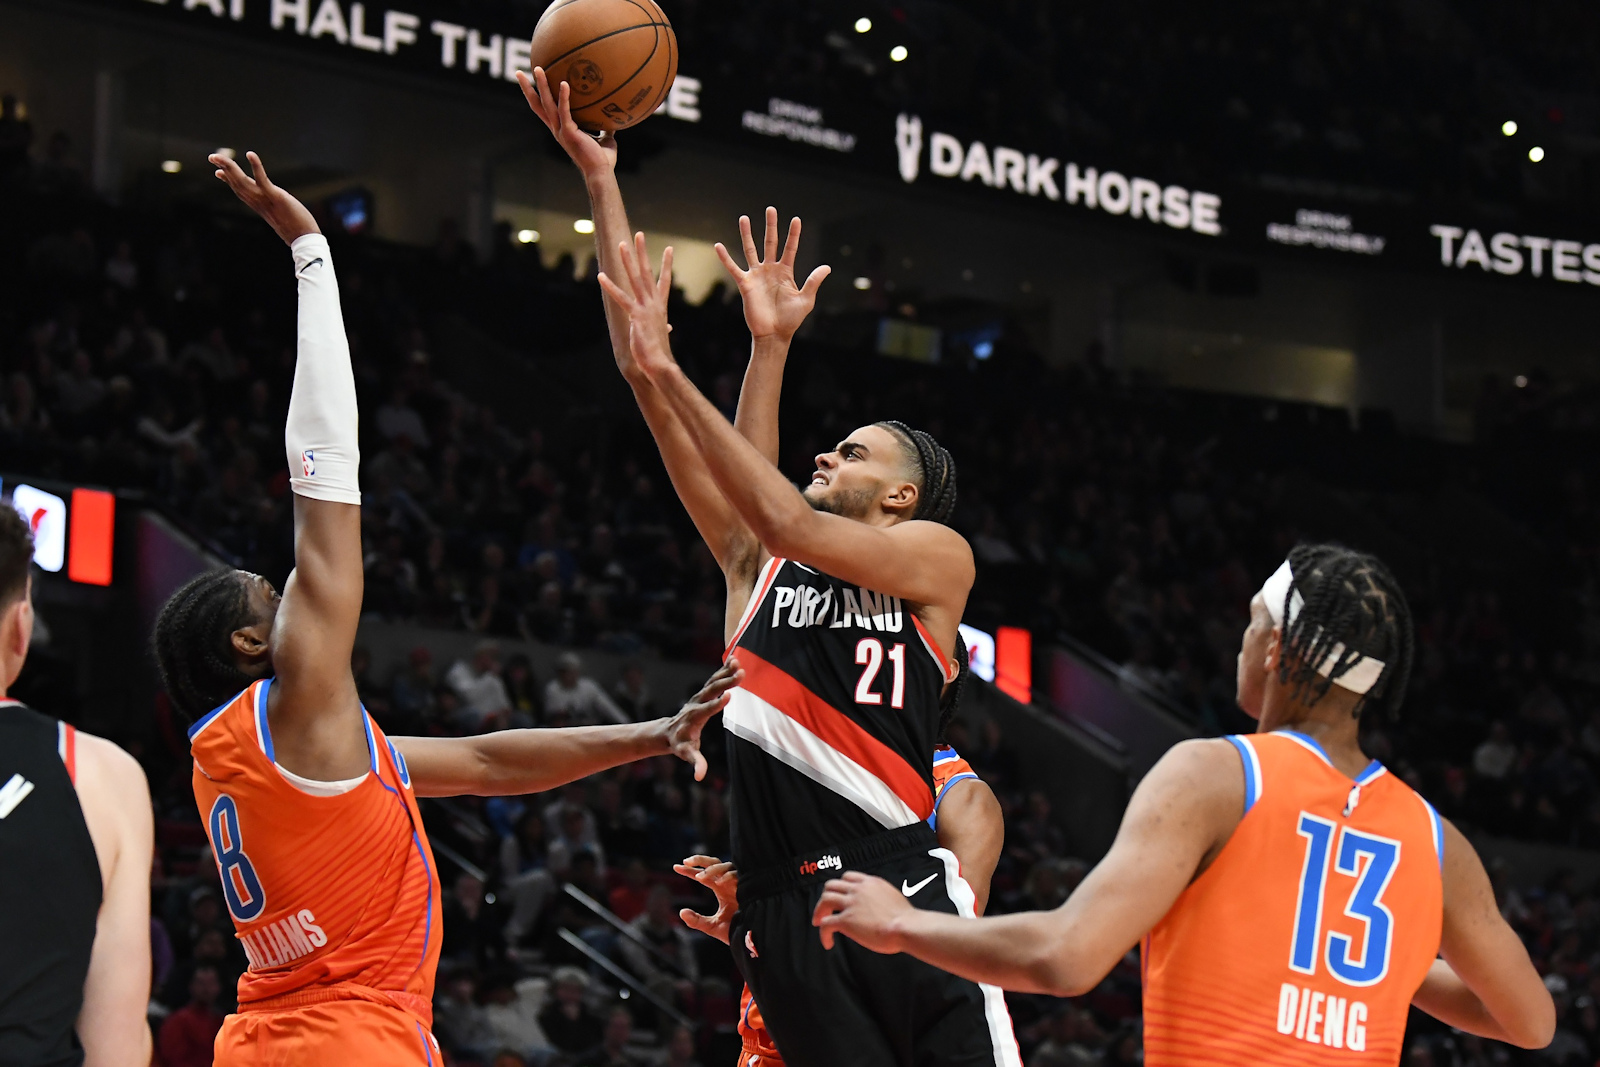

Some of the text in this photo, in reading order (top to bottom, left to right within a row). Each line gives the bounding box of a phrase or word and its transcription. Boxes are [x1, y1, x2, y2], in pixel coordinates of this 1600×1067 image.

[271, 0, 419, 54] HALF
[431, 21, 534, 85] THE
[930, 132, 1222, 236] DARK HORSE
[1430, 224, 1600, 286] TASTES
[771, 584, 903, 633] PORTLAND
[854, 637, 906, 709] 21
[209, 793, 266, 923] 8
[800, 854, 842, 875] ripcity
[1288, 810, 1402, 987] 13
[239, 908, 328, 972] ILLIAMS
[1276, 983, 1368, 1052] DIENG
